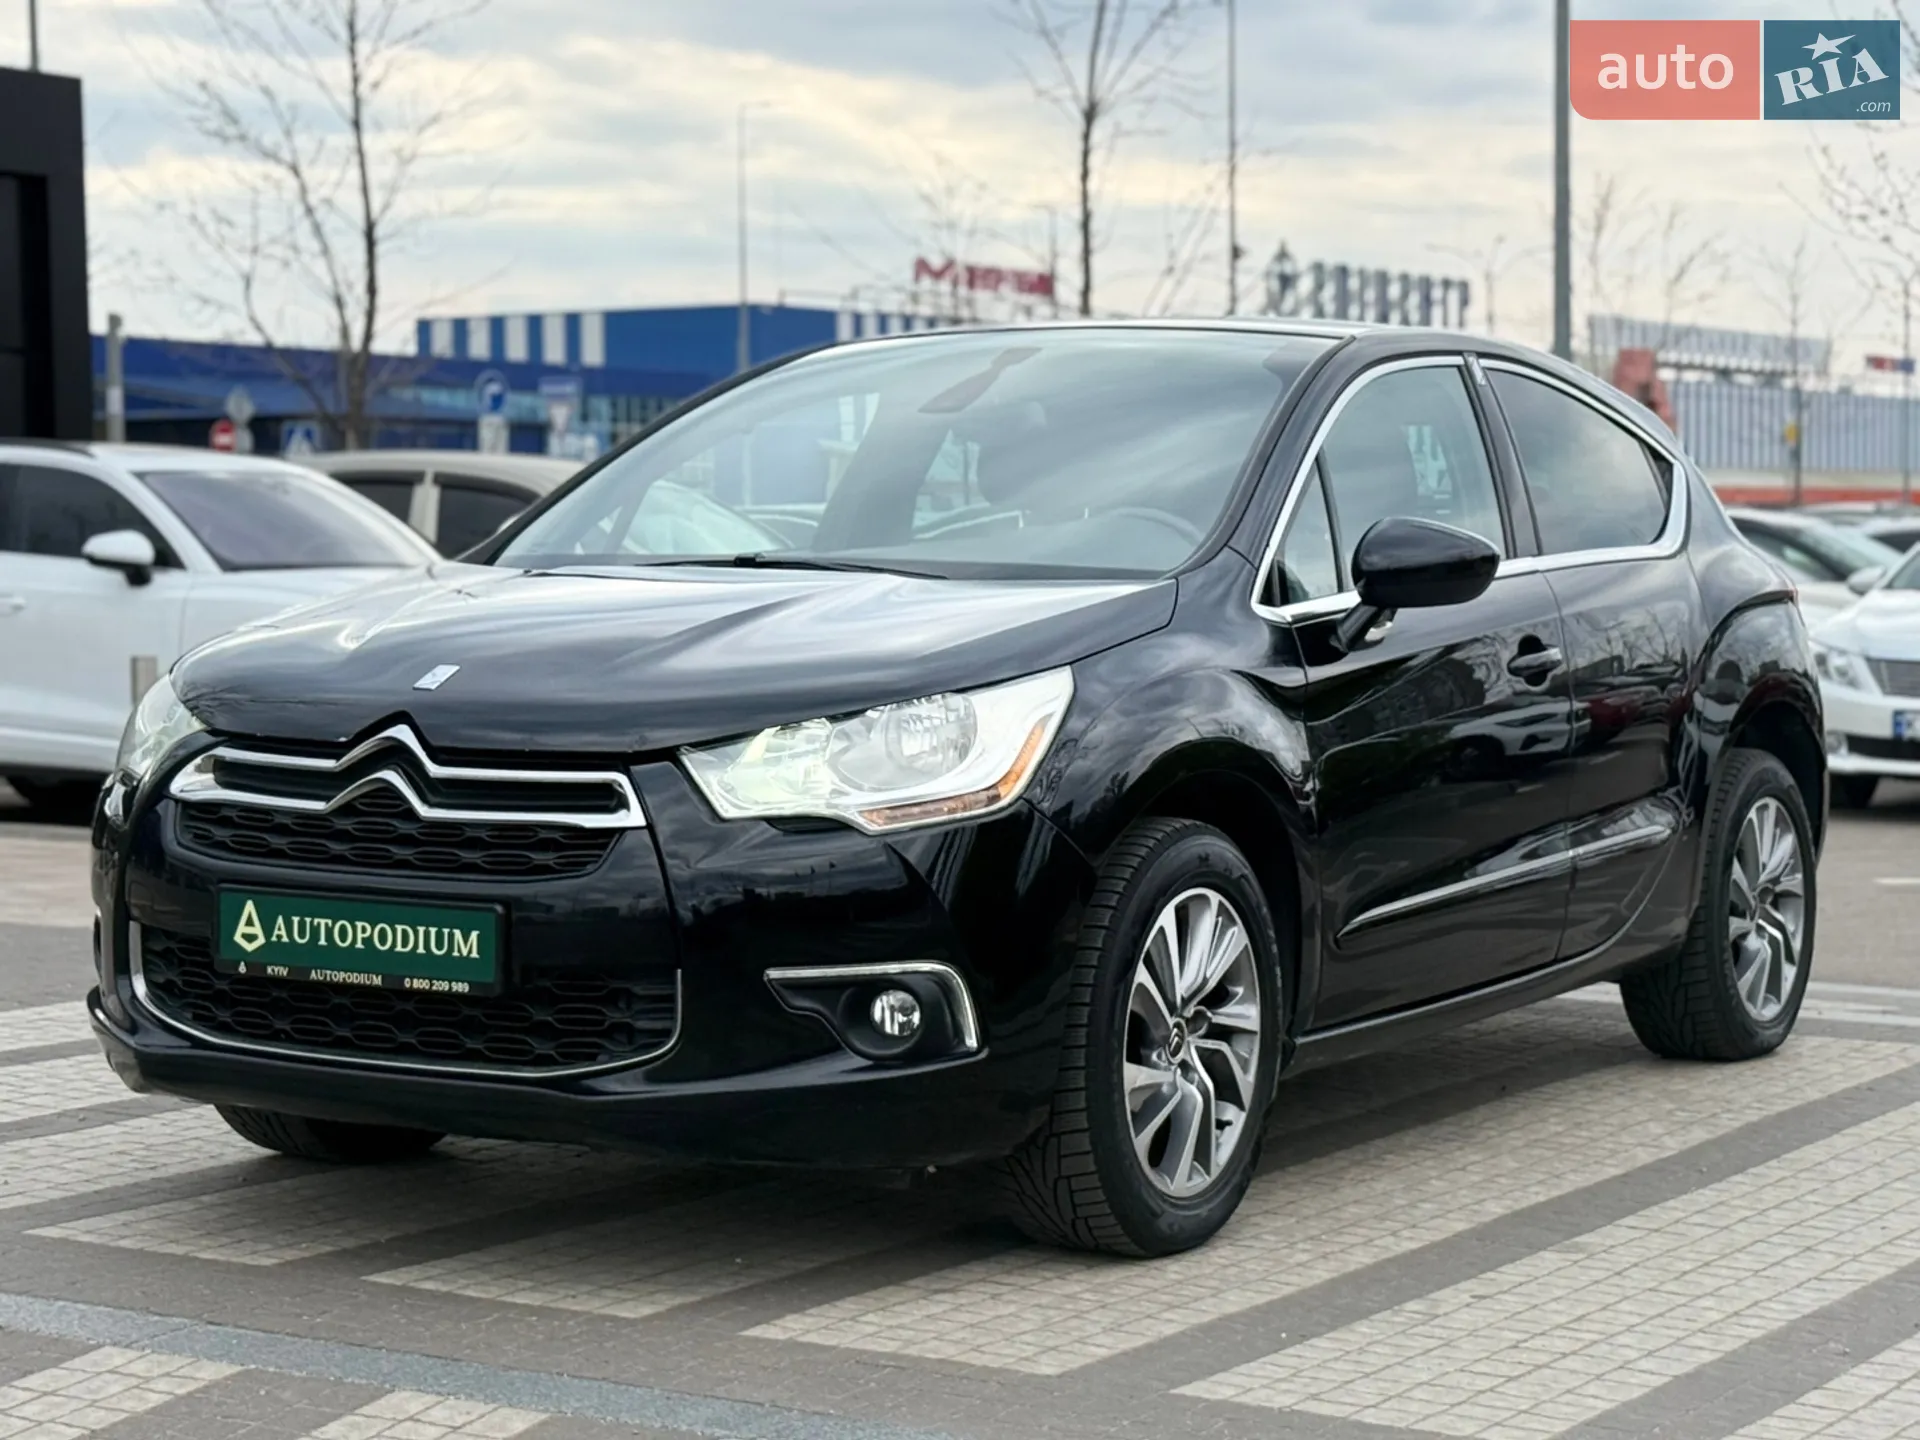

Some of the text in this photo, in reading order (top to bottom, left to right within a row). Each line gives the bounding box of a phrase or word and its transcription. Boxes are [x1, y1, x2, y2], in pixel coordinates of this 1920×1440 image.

[271, 914, 480, 958] AUTOPODIUM
[266, 965, 289, 977] KYIV
[309, 969, 382, 986] AUTOPODIUM
[404, 977, 470, 993] 0 800 209 989
